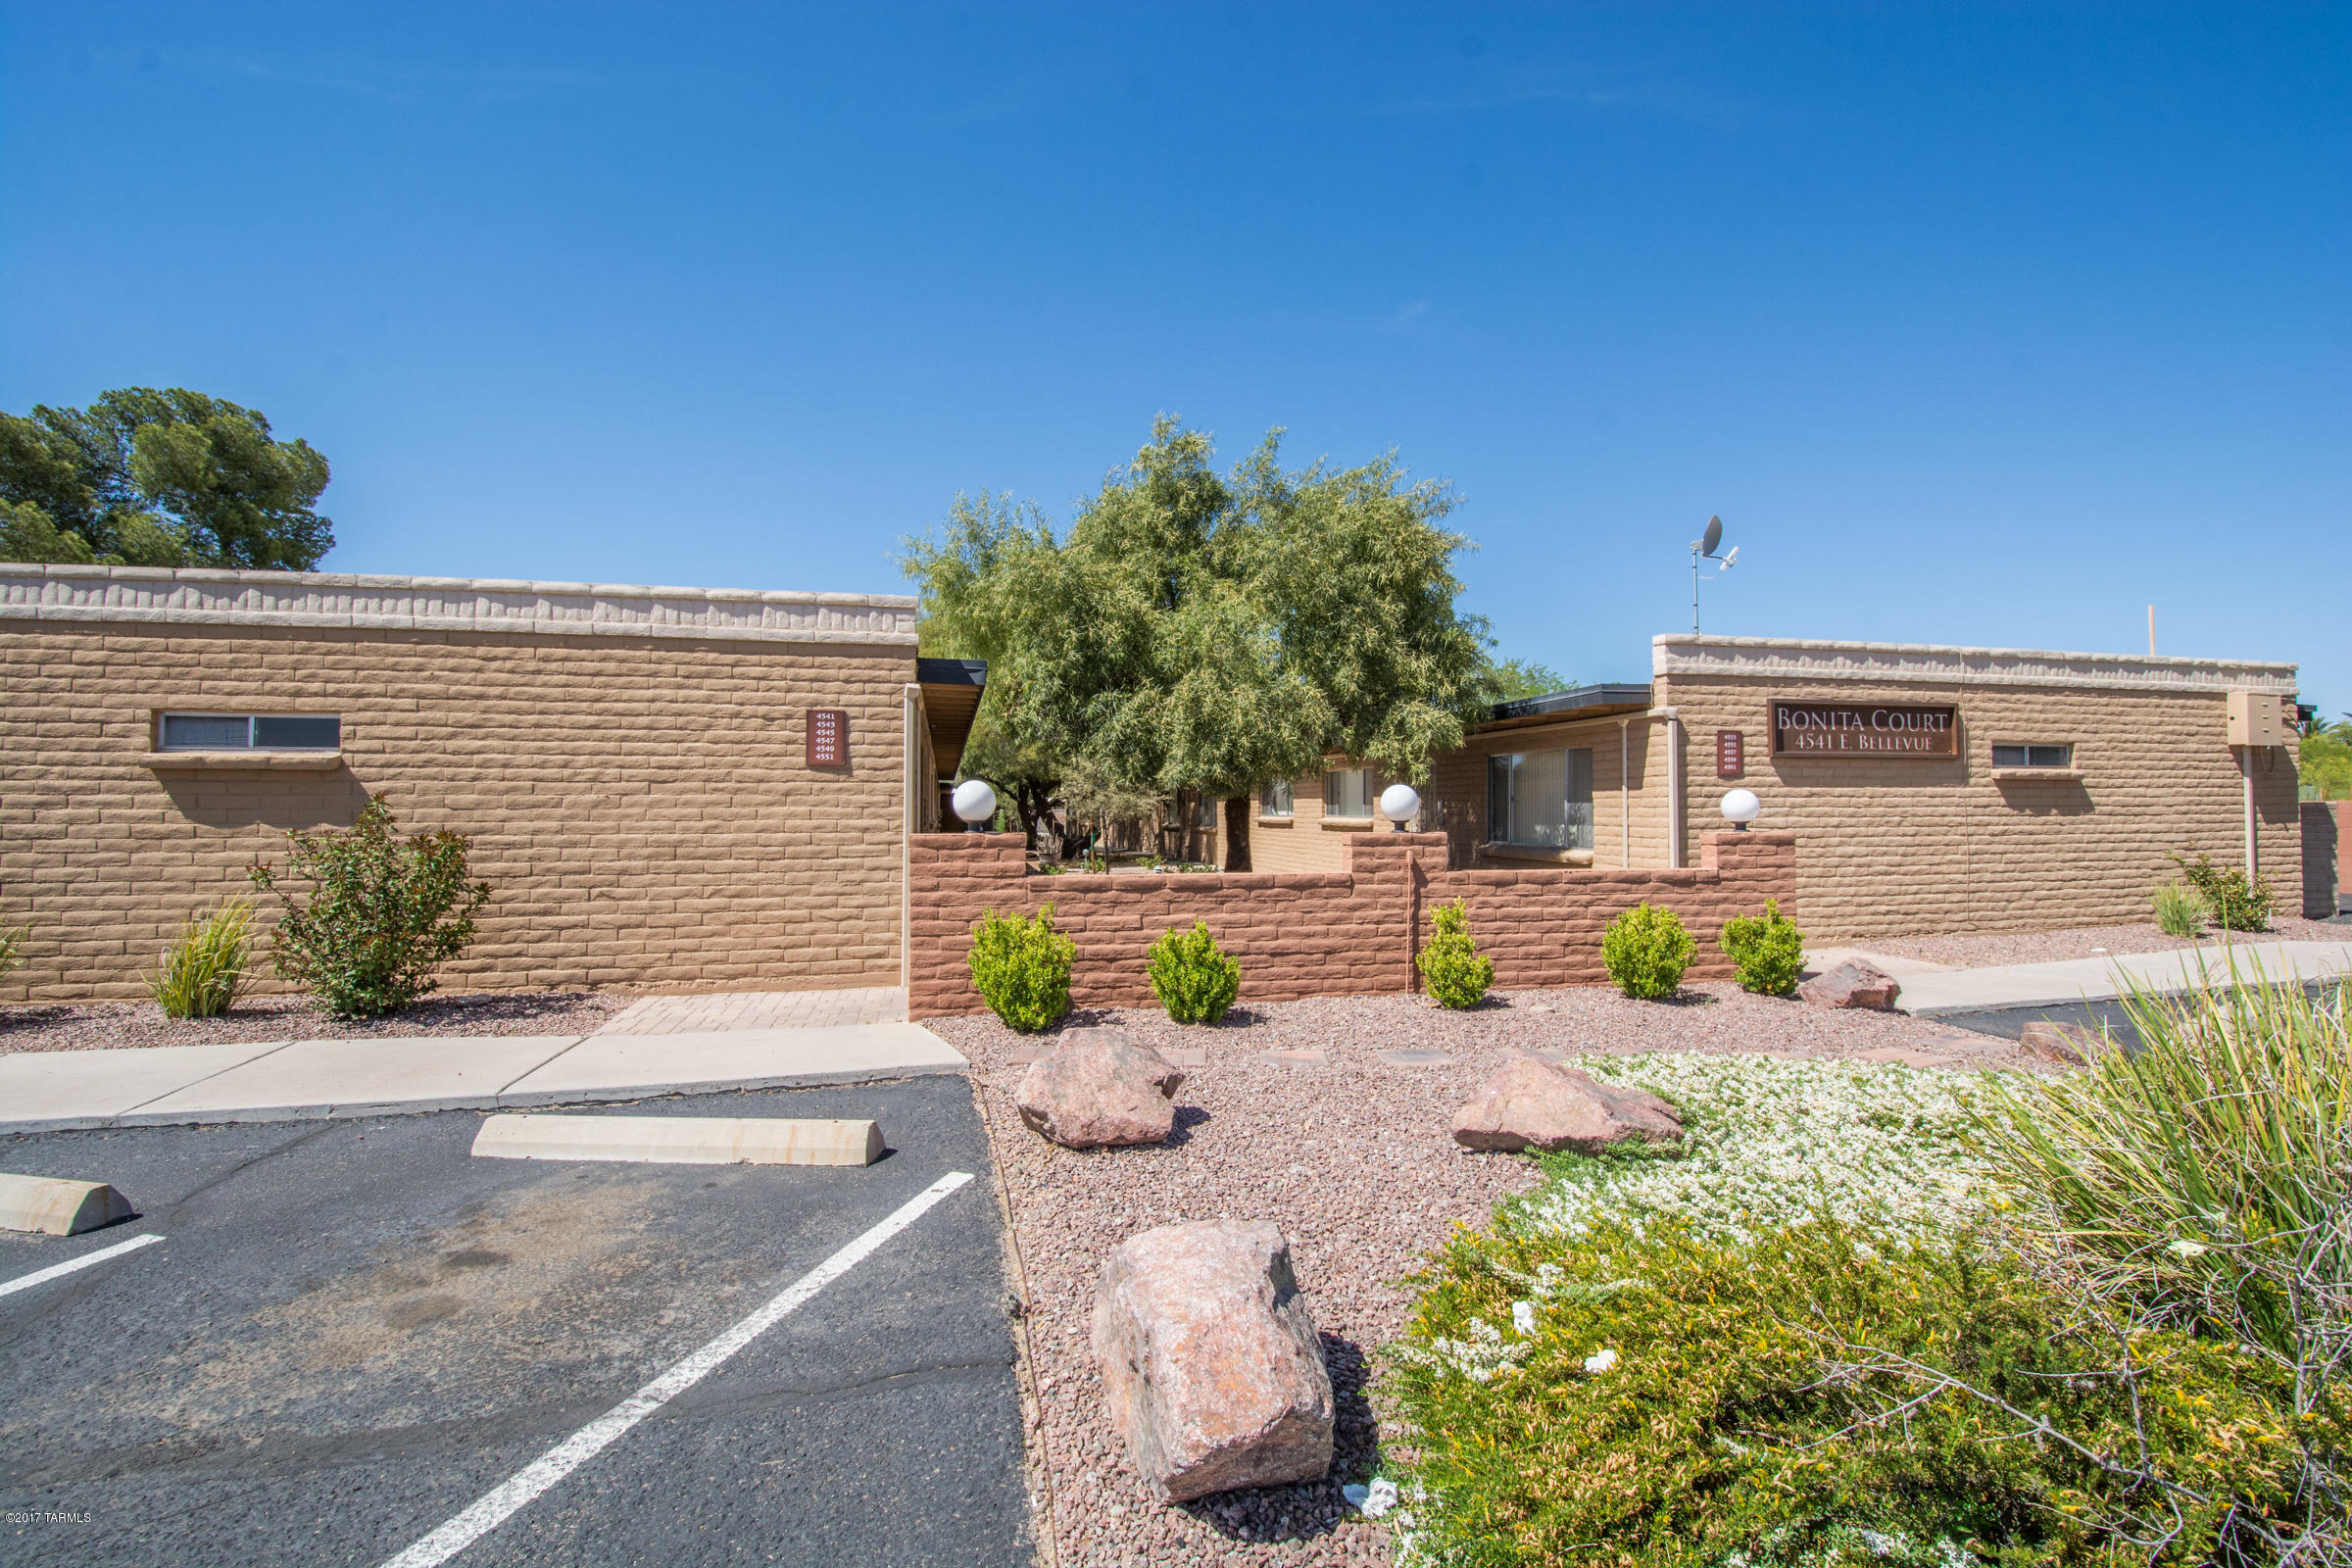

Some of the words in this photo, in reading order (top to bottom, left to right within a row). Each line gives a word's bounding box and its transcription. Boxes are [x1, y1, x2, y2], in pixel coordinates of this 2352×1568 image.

[1777, 708, 1865, 731] BONITA
[1871, 710, 1948, 733] COURT
[1794, 733, 1833, 750] 4541
[1840, 733, 1853, 750] E.
[1859, 734, 1933, 751] BELLEVUE
